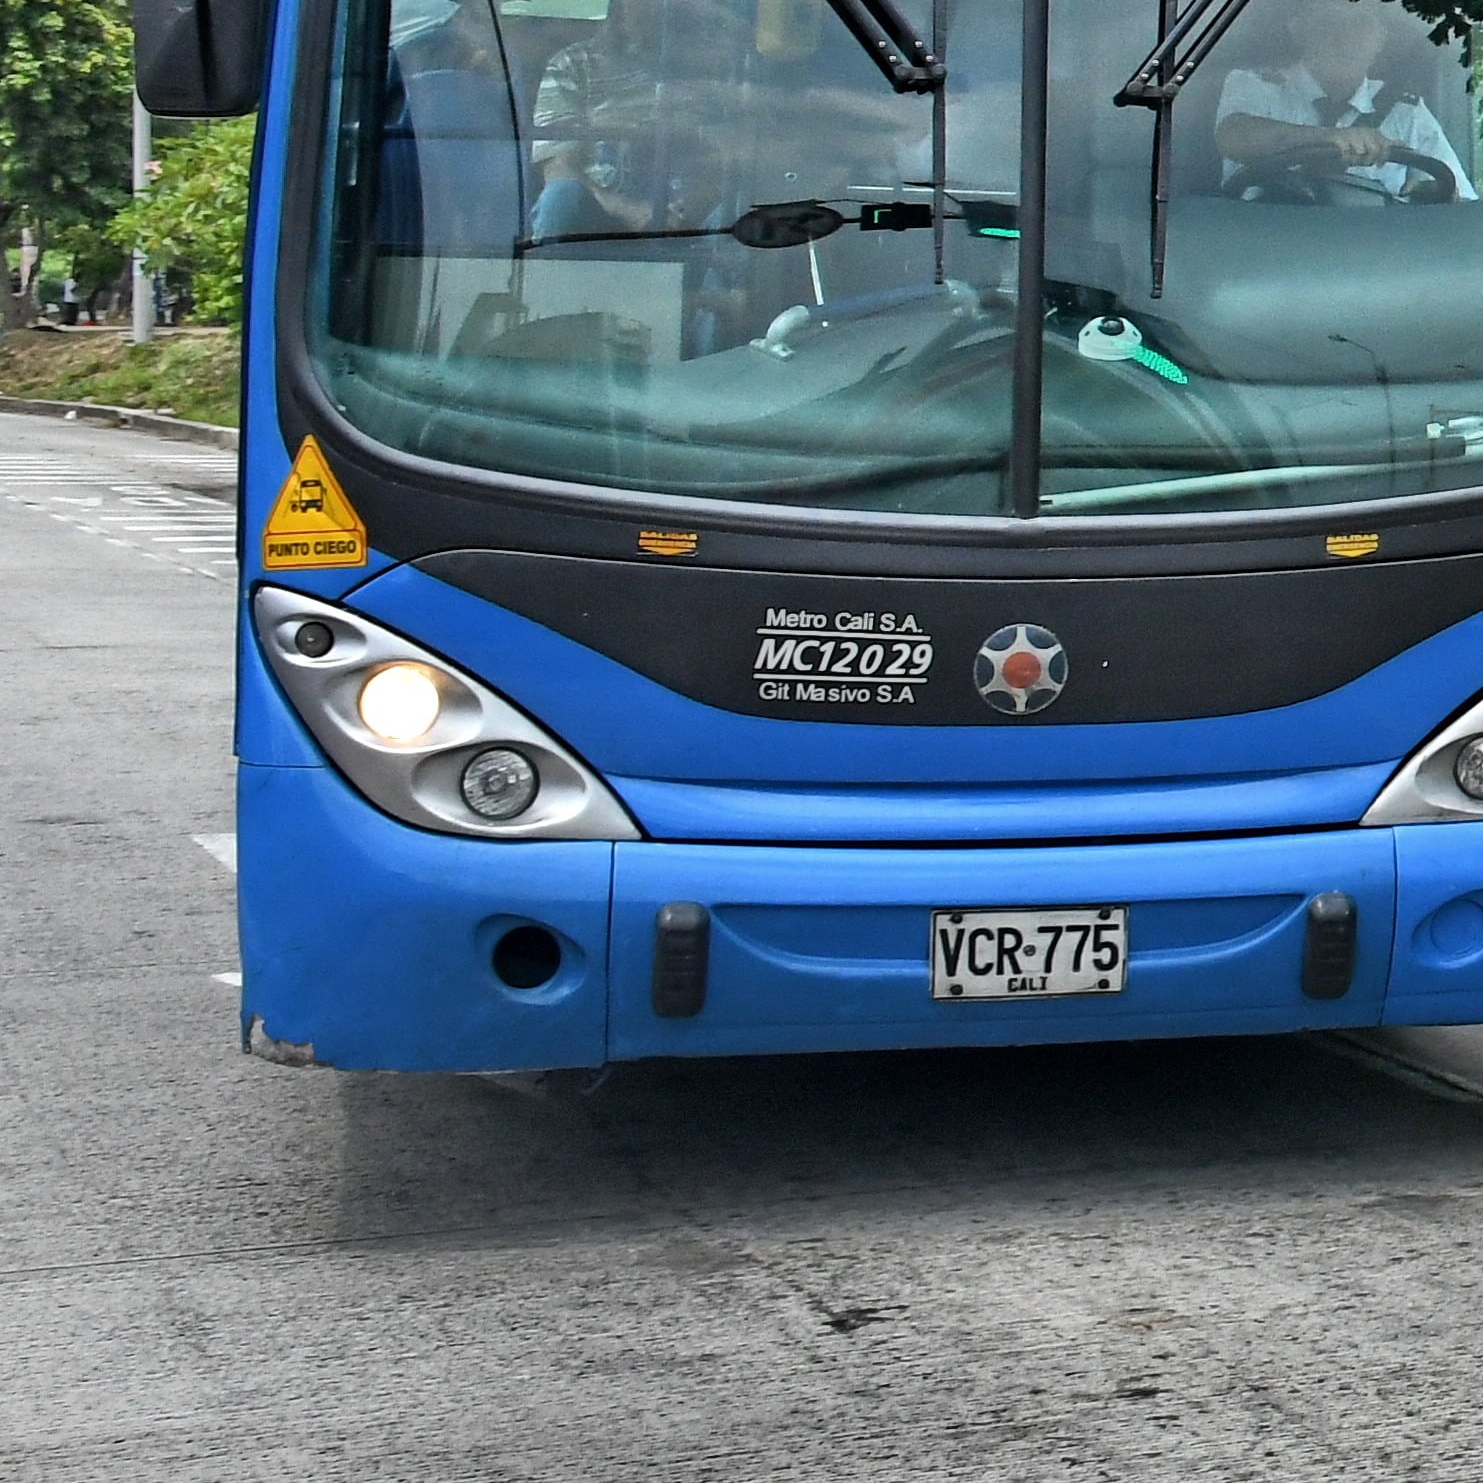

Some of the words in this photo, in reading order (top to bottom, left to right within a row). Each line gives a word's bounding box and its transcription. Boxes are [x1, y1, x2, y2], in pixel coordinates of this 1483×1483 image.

[268, 542, 310, 557] PUNTO
[313, 539, 357, 555] CIEGO
[766, 608, 827, 629] Metro
[834, 612, 874, 631] Cali
[879, 614, 924, 633] S.A.
[754, 638, 934, 675] MC12029
[758, 682, 790, 701] Git
[795, 683, 871, 703] Masivo
[876, 685, 915, 704] S.A
[1007, 976, 1049, 992] CALI
